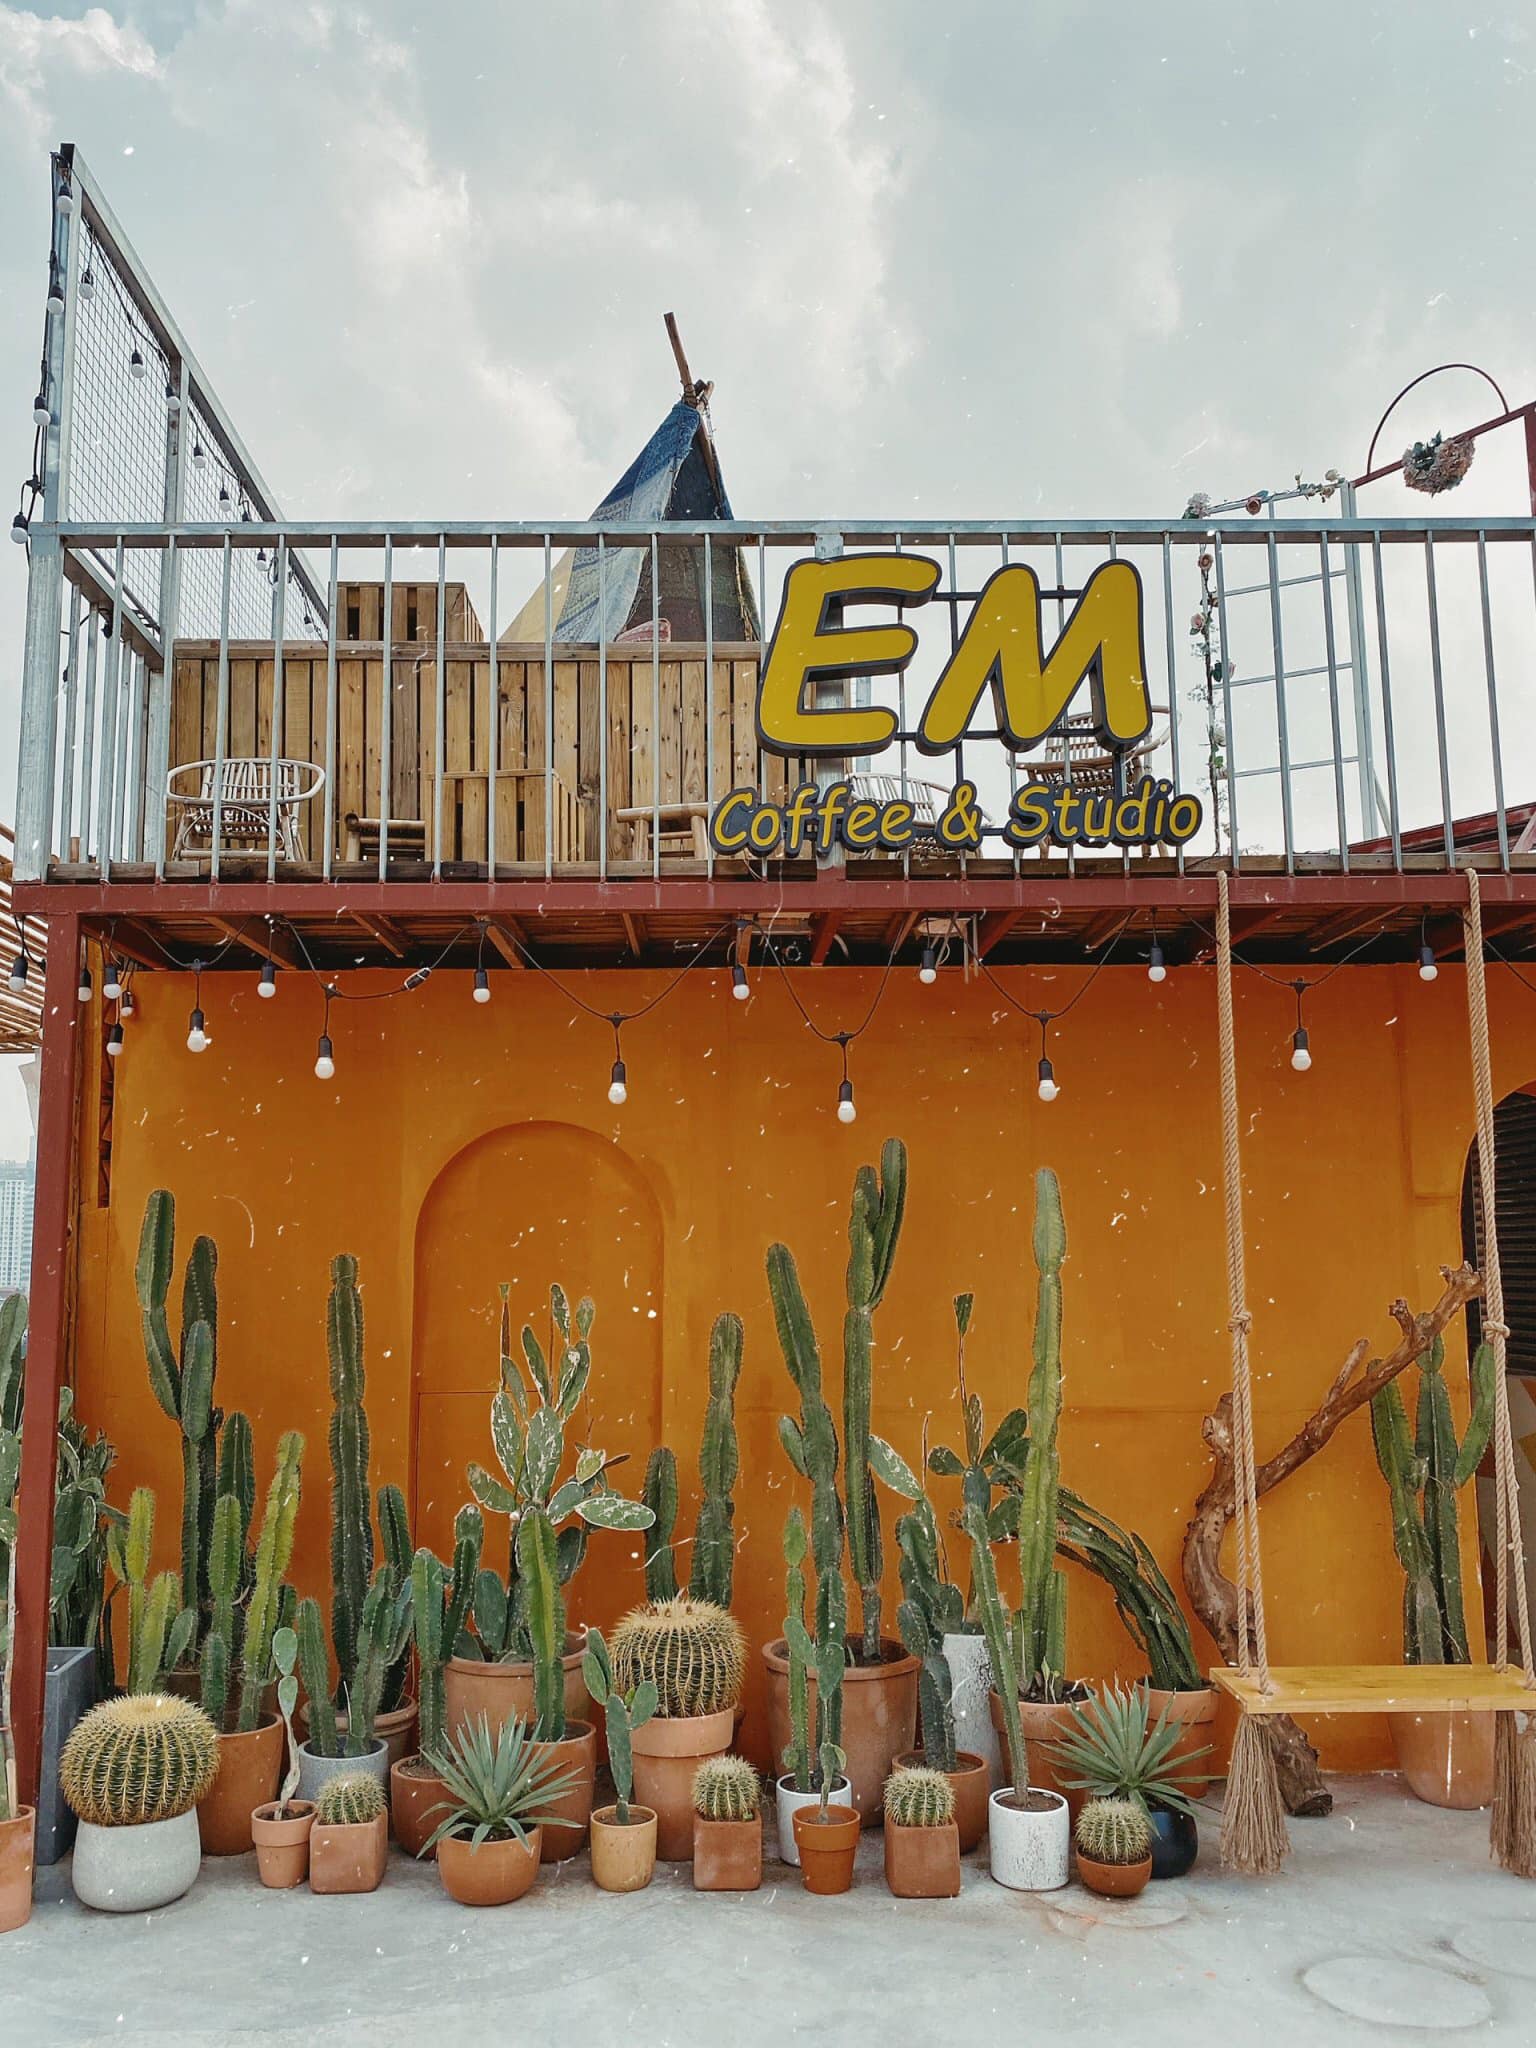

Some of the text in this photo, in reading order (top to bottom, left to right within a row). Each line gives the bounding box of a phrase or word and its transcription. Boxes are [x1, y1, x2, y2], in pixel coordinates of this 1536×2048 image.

[756, 553, 1152, 756] EM
[712, 779, 1201, 852] Coffee & Studio
